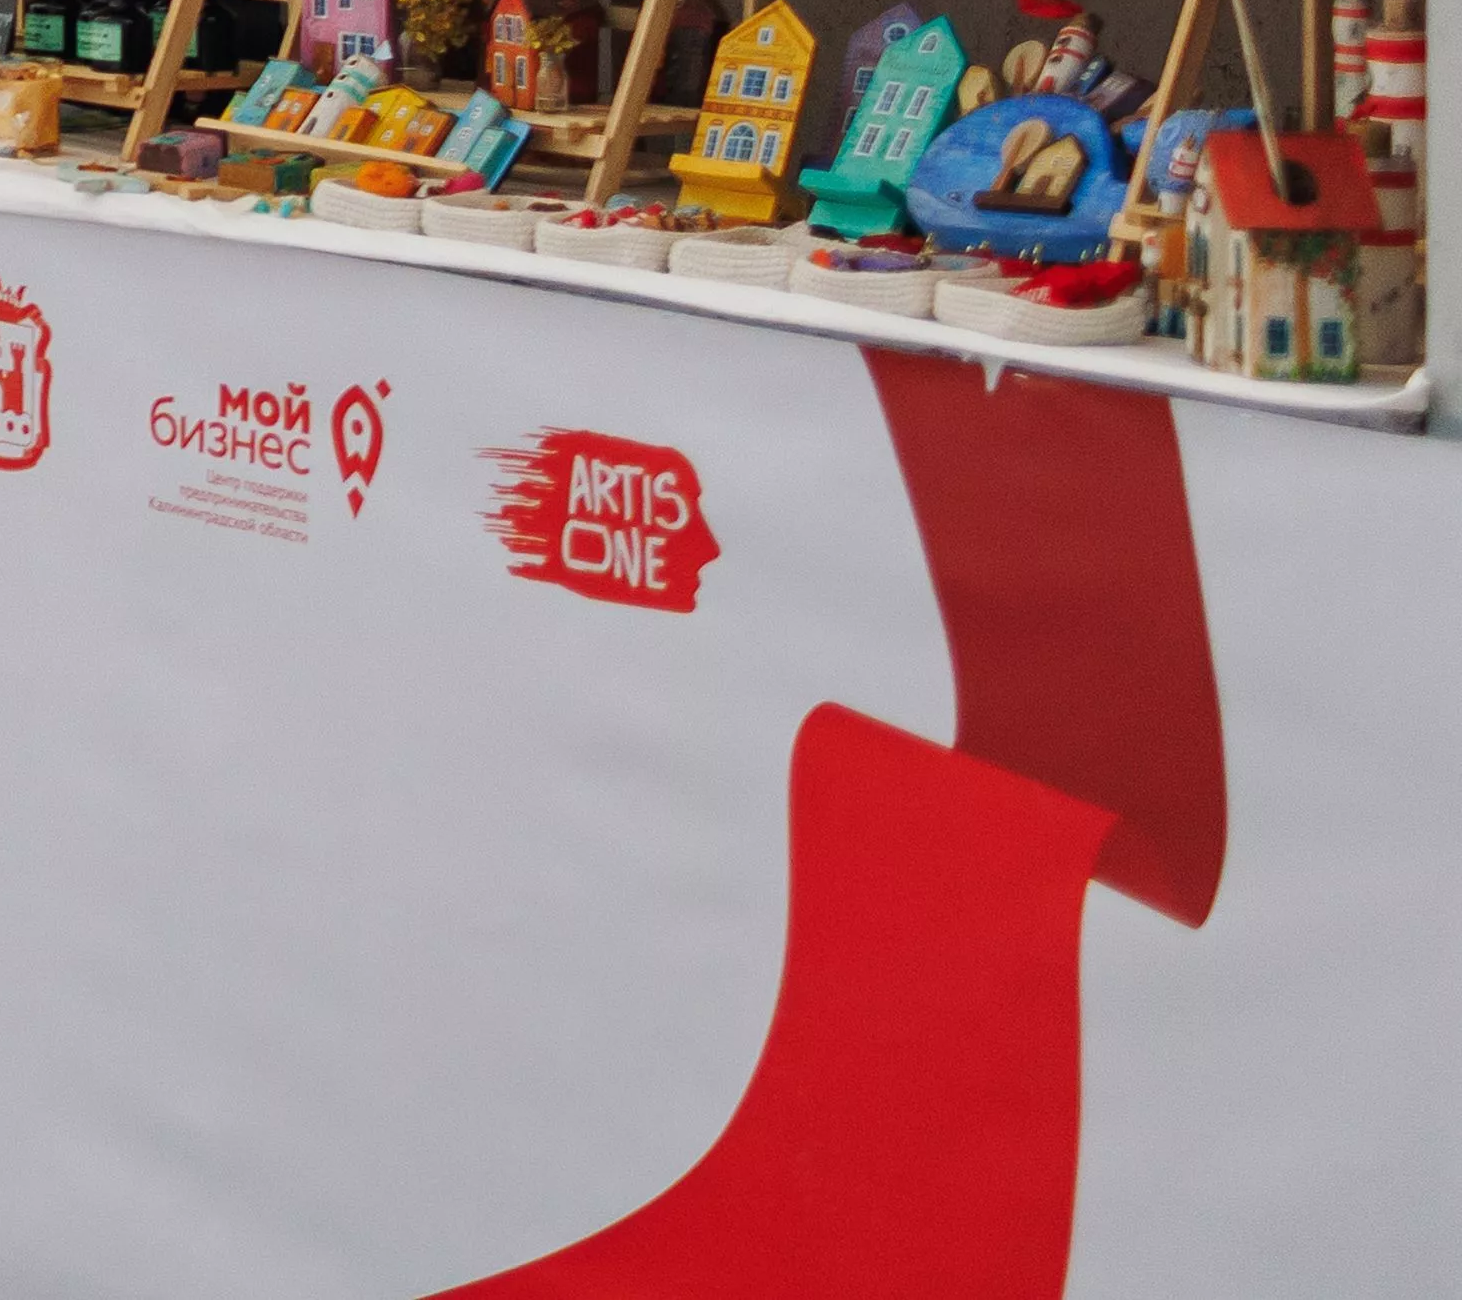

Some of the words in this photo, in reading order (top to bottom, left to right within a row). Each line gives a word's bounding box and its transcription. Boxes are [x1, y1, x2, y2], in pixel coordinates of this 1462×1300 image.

[150, 396, 311, 475] бизнес
[219, 382, 311, 434] мой
[568, 454, 688, 530] ARTIS
[561, 518, 666, 590] ONE
